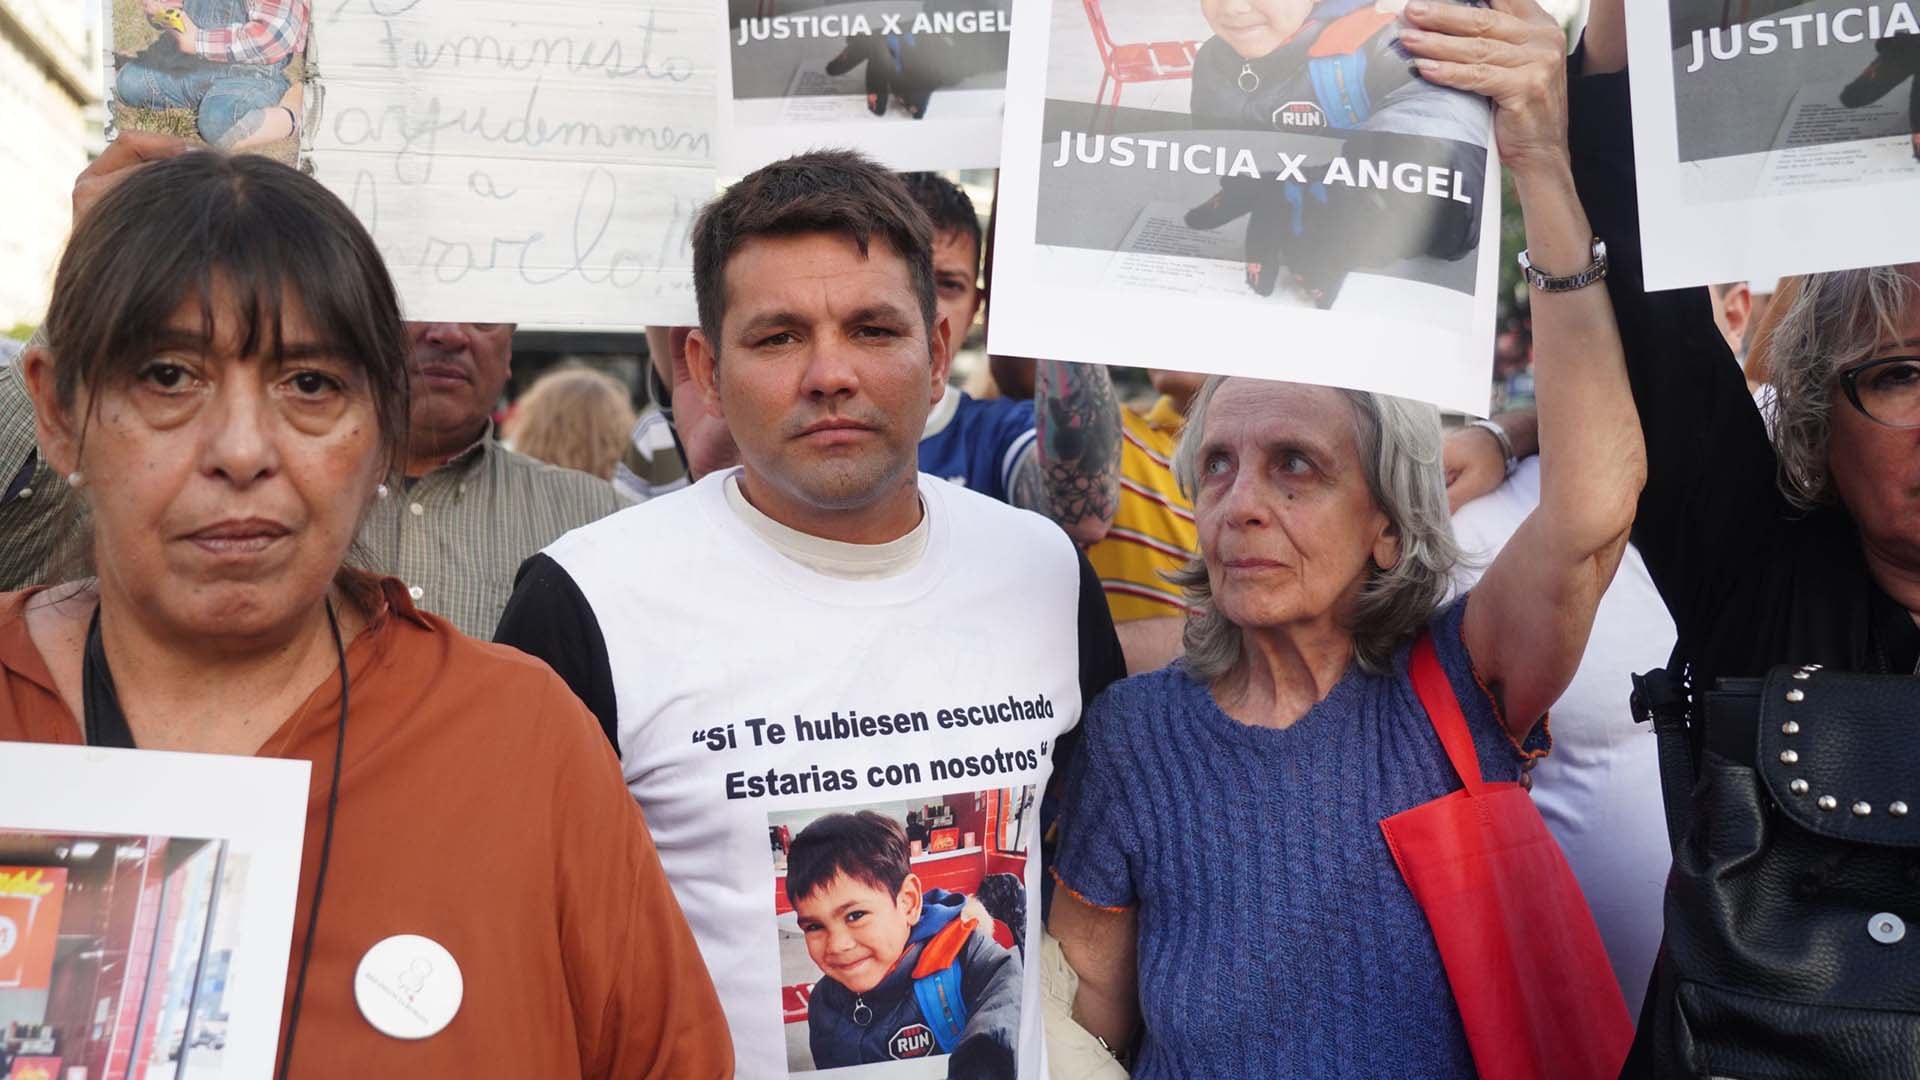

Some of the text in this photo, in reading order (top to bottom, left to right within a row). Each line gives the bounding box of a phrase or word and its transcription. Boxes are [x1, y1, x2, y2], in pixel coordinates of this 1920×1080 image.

[738, 11, 1011, 46] JUSTICIA X ANGEL
[1687, 2, 1920, 72] JUSTICIA
[1282, 111, 1321, 126] RUN
[1053, 131, 1472, 204] JUSTICIA X ANGEL
[745, 718, 786, 746] Te
[794, 710, 929, 742] hubiesen
[936, 694, 1054, 729] escuchado
[726, 765, 857, 800] Estarias
[866, 761, 921, 788] con
[897, 1031, 931, 1053] RUN
